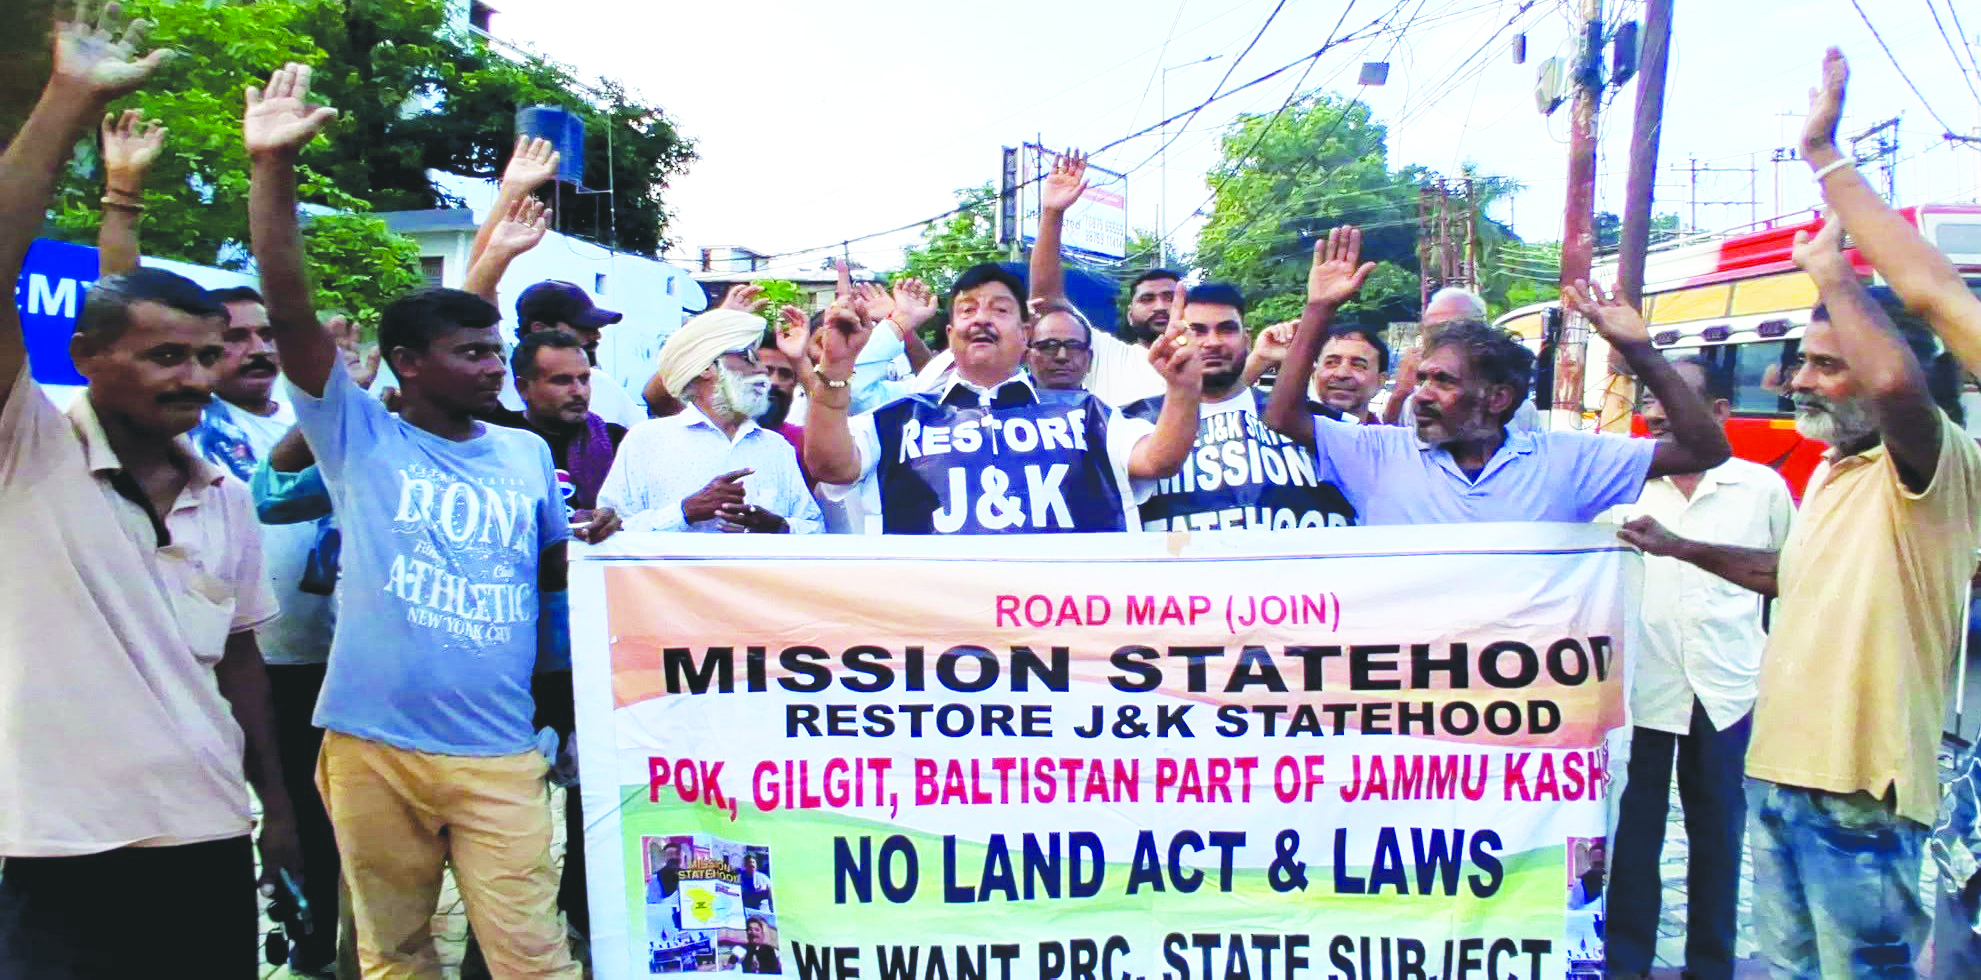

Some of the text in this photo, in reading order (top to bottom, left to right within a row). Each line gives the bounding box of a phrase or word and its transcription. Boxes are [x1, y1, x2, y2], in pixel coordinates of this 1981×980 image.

[899, 408, 1088, 464] RESTORE
[1203, 410, 1243, 444] J&K
[932, 463, 1075, 533] J&K
[383, 554, 530, 623] ATHLETIC
[996, 592, 1341, 634] ROAD MAP (JOIN)
[406, 606, 443, 630] NEW
[663, 636, 1612, 694] MISSION STATEHOOD
[785, 700, 1562, 739] RESTORE J&K STATEHOOD
[648, 751, 1610, 822] POK, GILGIT, BALTISTAN PART OF JAMMU KASH
[834, 827, 1504, 905] NO LAND ACT & LAWS
[791, 940, 859, 980] WE
[876, 944, 1020, 980] WANT
[1163, 932, 1309, 980] STATE
[1328, 935, 1552, 980] SUBJECT
